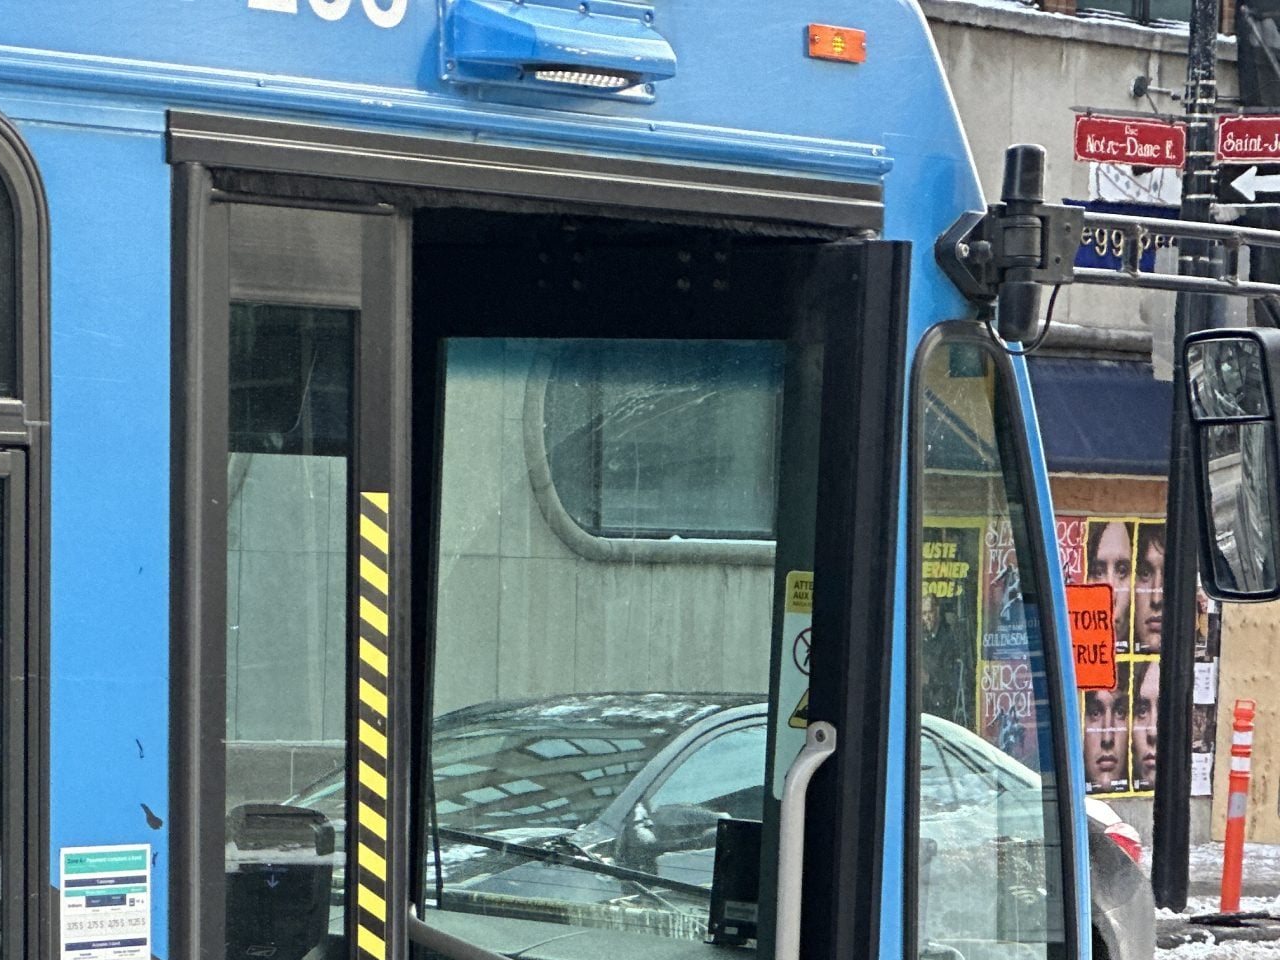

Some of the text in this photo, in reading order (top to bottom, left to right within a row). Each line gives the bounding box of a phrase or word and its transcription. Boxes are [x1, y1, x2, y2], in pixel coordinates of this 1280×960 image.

[1085, 134, 1176, 159] Notre-Dame E.
[1223, 132, 1280, 152] Saint-J
[793, 591, 809, 600] AUX
[1068, 610, 1109, 630] TOIR
[1073, 641, 1108, 665] RUÉ
